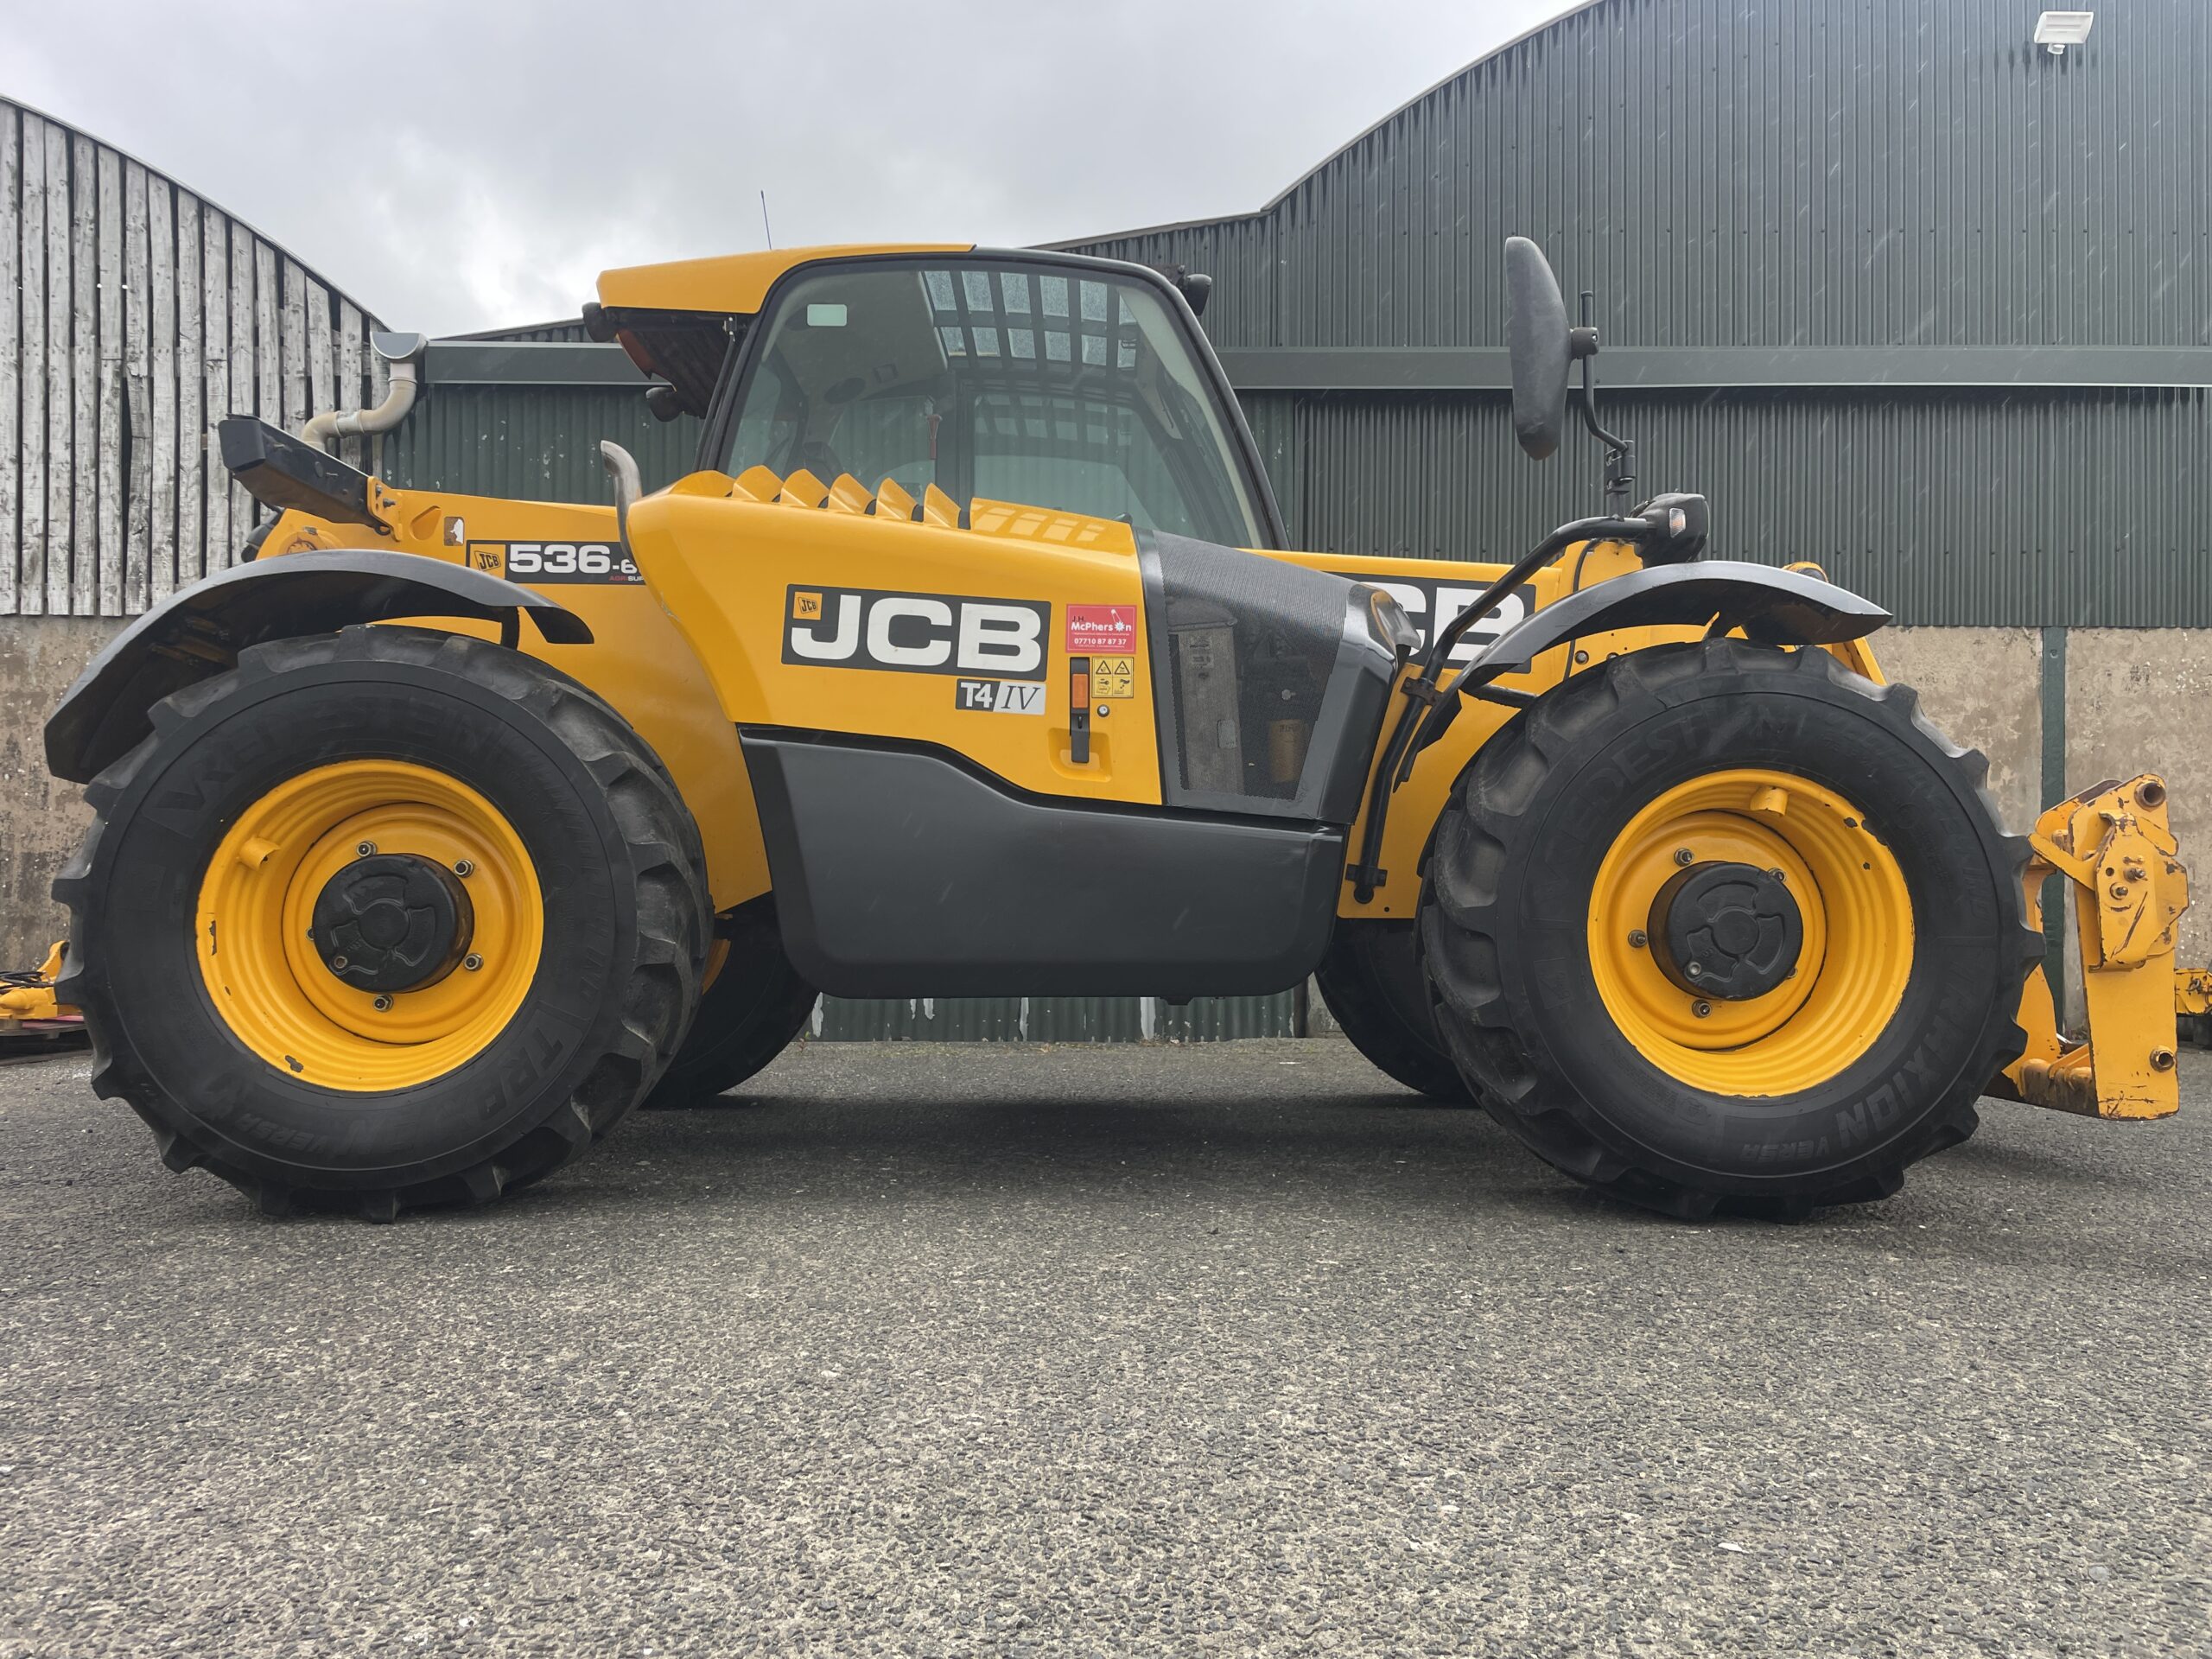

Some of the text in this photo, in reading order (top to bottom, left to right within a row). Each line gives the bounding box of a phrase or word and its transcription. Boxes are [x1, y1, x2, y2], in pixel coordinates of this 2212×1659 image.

[479, 553, 500, 570] JCB
[791, 594, 1041, 672] JCB
[960, 682, 1041, 710] T4 IV
[236, 1114, 331, 1154] VERSA
[1739, 1136, 1830, 1163] VERSA
